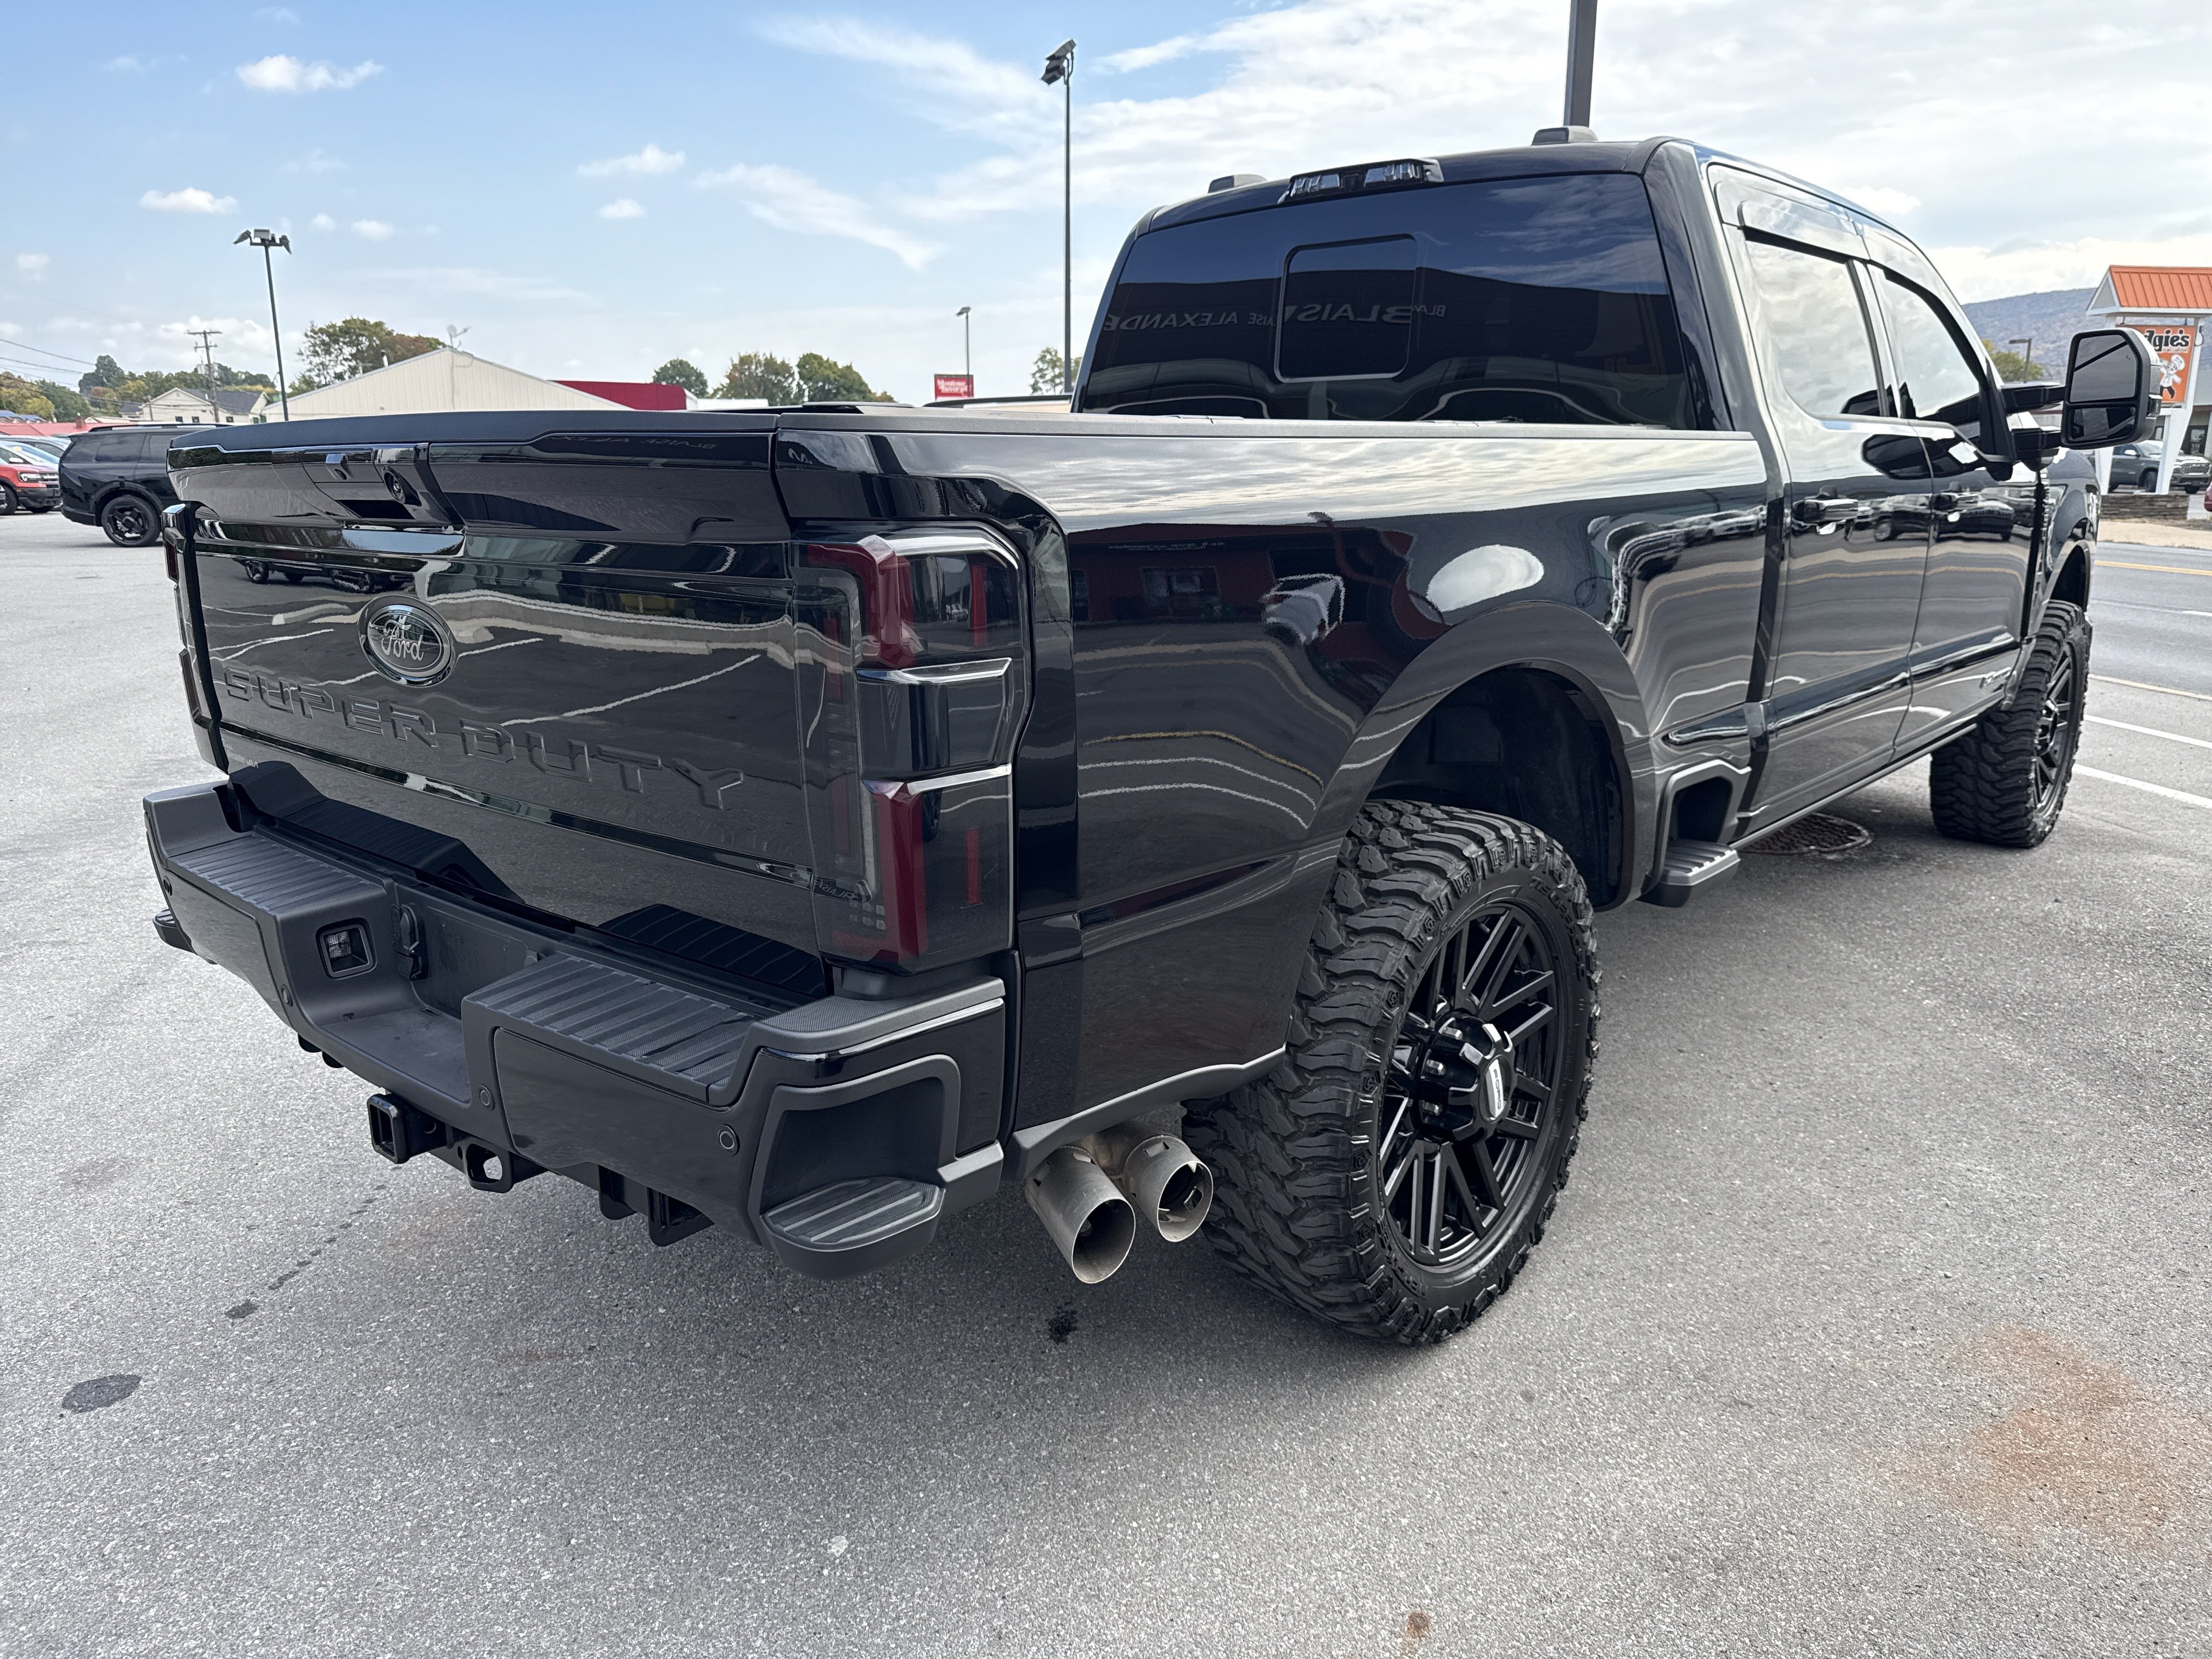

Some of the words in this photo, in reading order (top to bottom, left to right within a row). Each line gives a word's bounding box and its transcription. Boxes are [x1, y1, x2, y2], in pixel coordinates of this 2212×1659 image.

[381, 619, 424, 661] Ford
[224, 667, 438, 748] SUPER
[459, 718, 744, 809] DUTY
